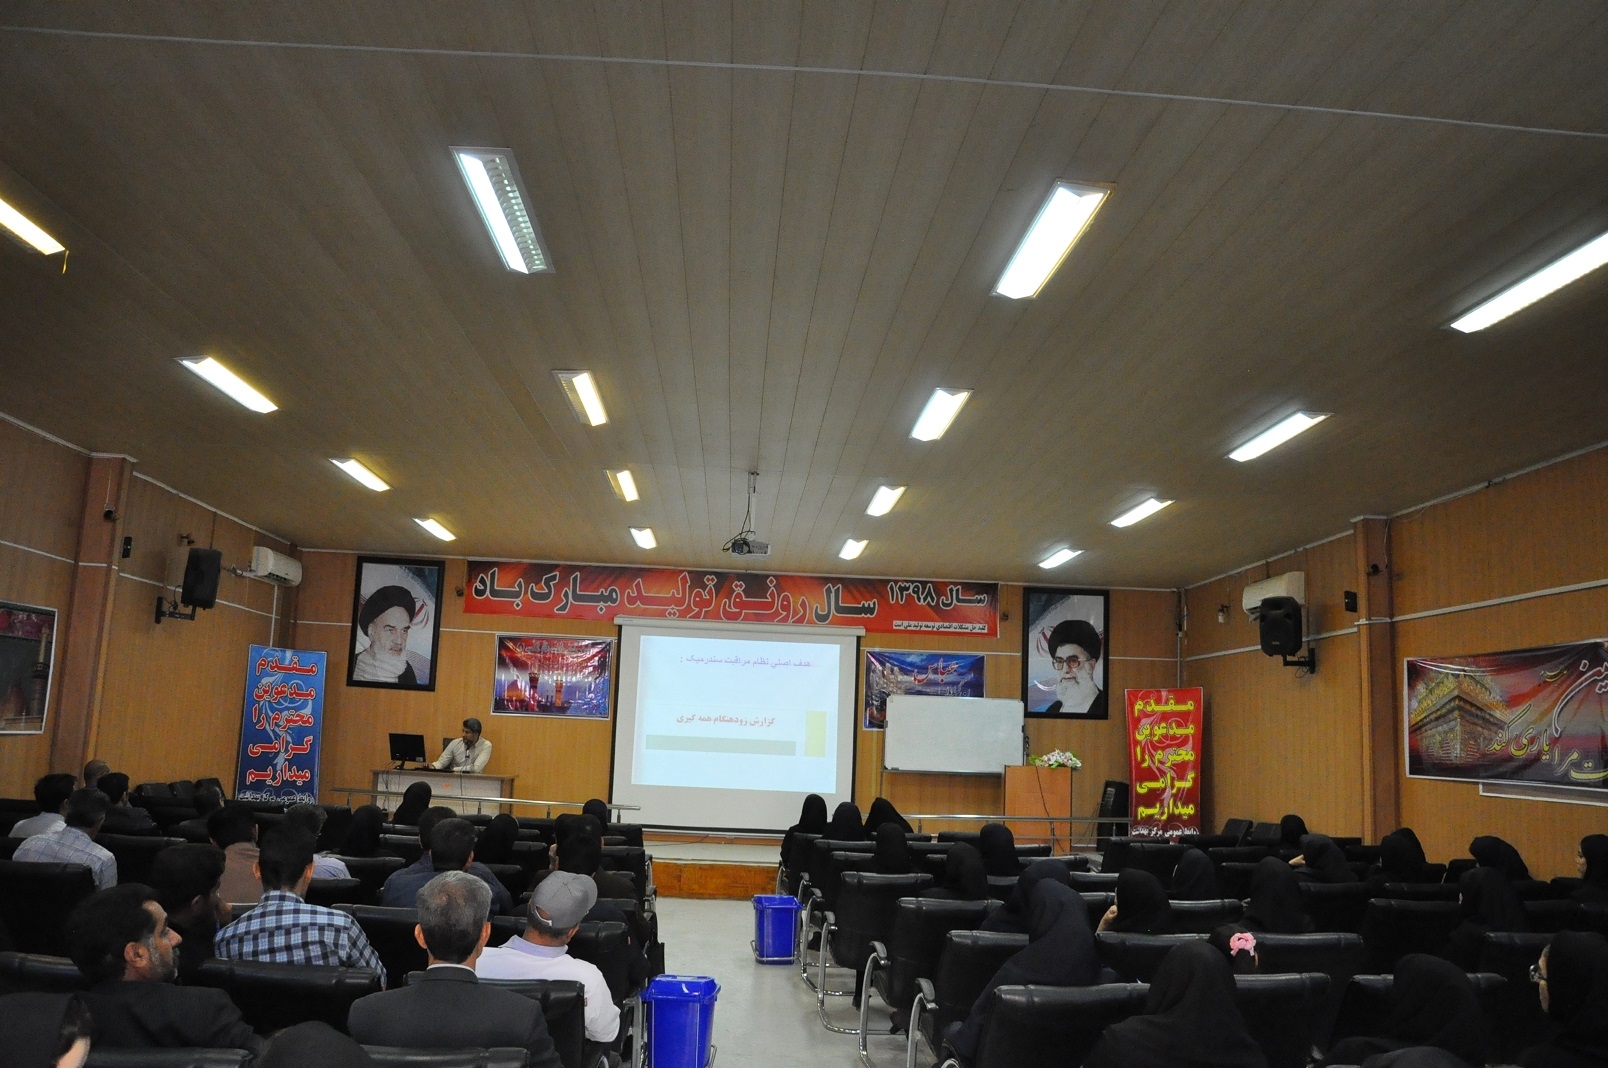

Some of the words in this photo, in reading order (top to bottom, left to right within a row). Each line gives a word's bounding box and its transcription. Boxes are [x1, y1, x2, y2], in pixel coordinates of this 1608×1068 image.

[472, 567, 525, 610] باد
[528, 572, 620, 614] مبارک
[624, 571, 717, 619] تولید
[720, 576, 809, 624] رونق
[887, 581, 937, 606] ۱۳۹۸
[940, 585, 988, 609] سال
[813, 583, 878, 625] سال
[256, 655, 318, 675] مقدم
[724, 656, 751, 666] مراقبت
[753, 657, 769, 668] نظام
[253, 681, 316, 703] مدعوین
[252, 704, 266, 729] را
[1134, 695, 1195, 717] مقدم
[270, 709, 314, 730] محترم
[1135, 720, 1195, 741] مدعوین
[247, 733, 314, 758] گرامی
[1136, 745, 1150, 767] را
[1154, 747, 1195, 767] محترم
[246, 761, 311, 786] میداریم
[1136, 770, 1196, 794] گرامی
[1137, 797, 1195, 820] میداریم
